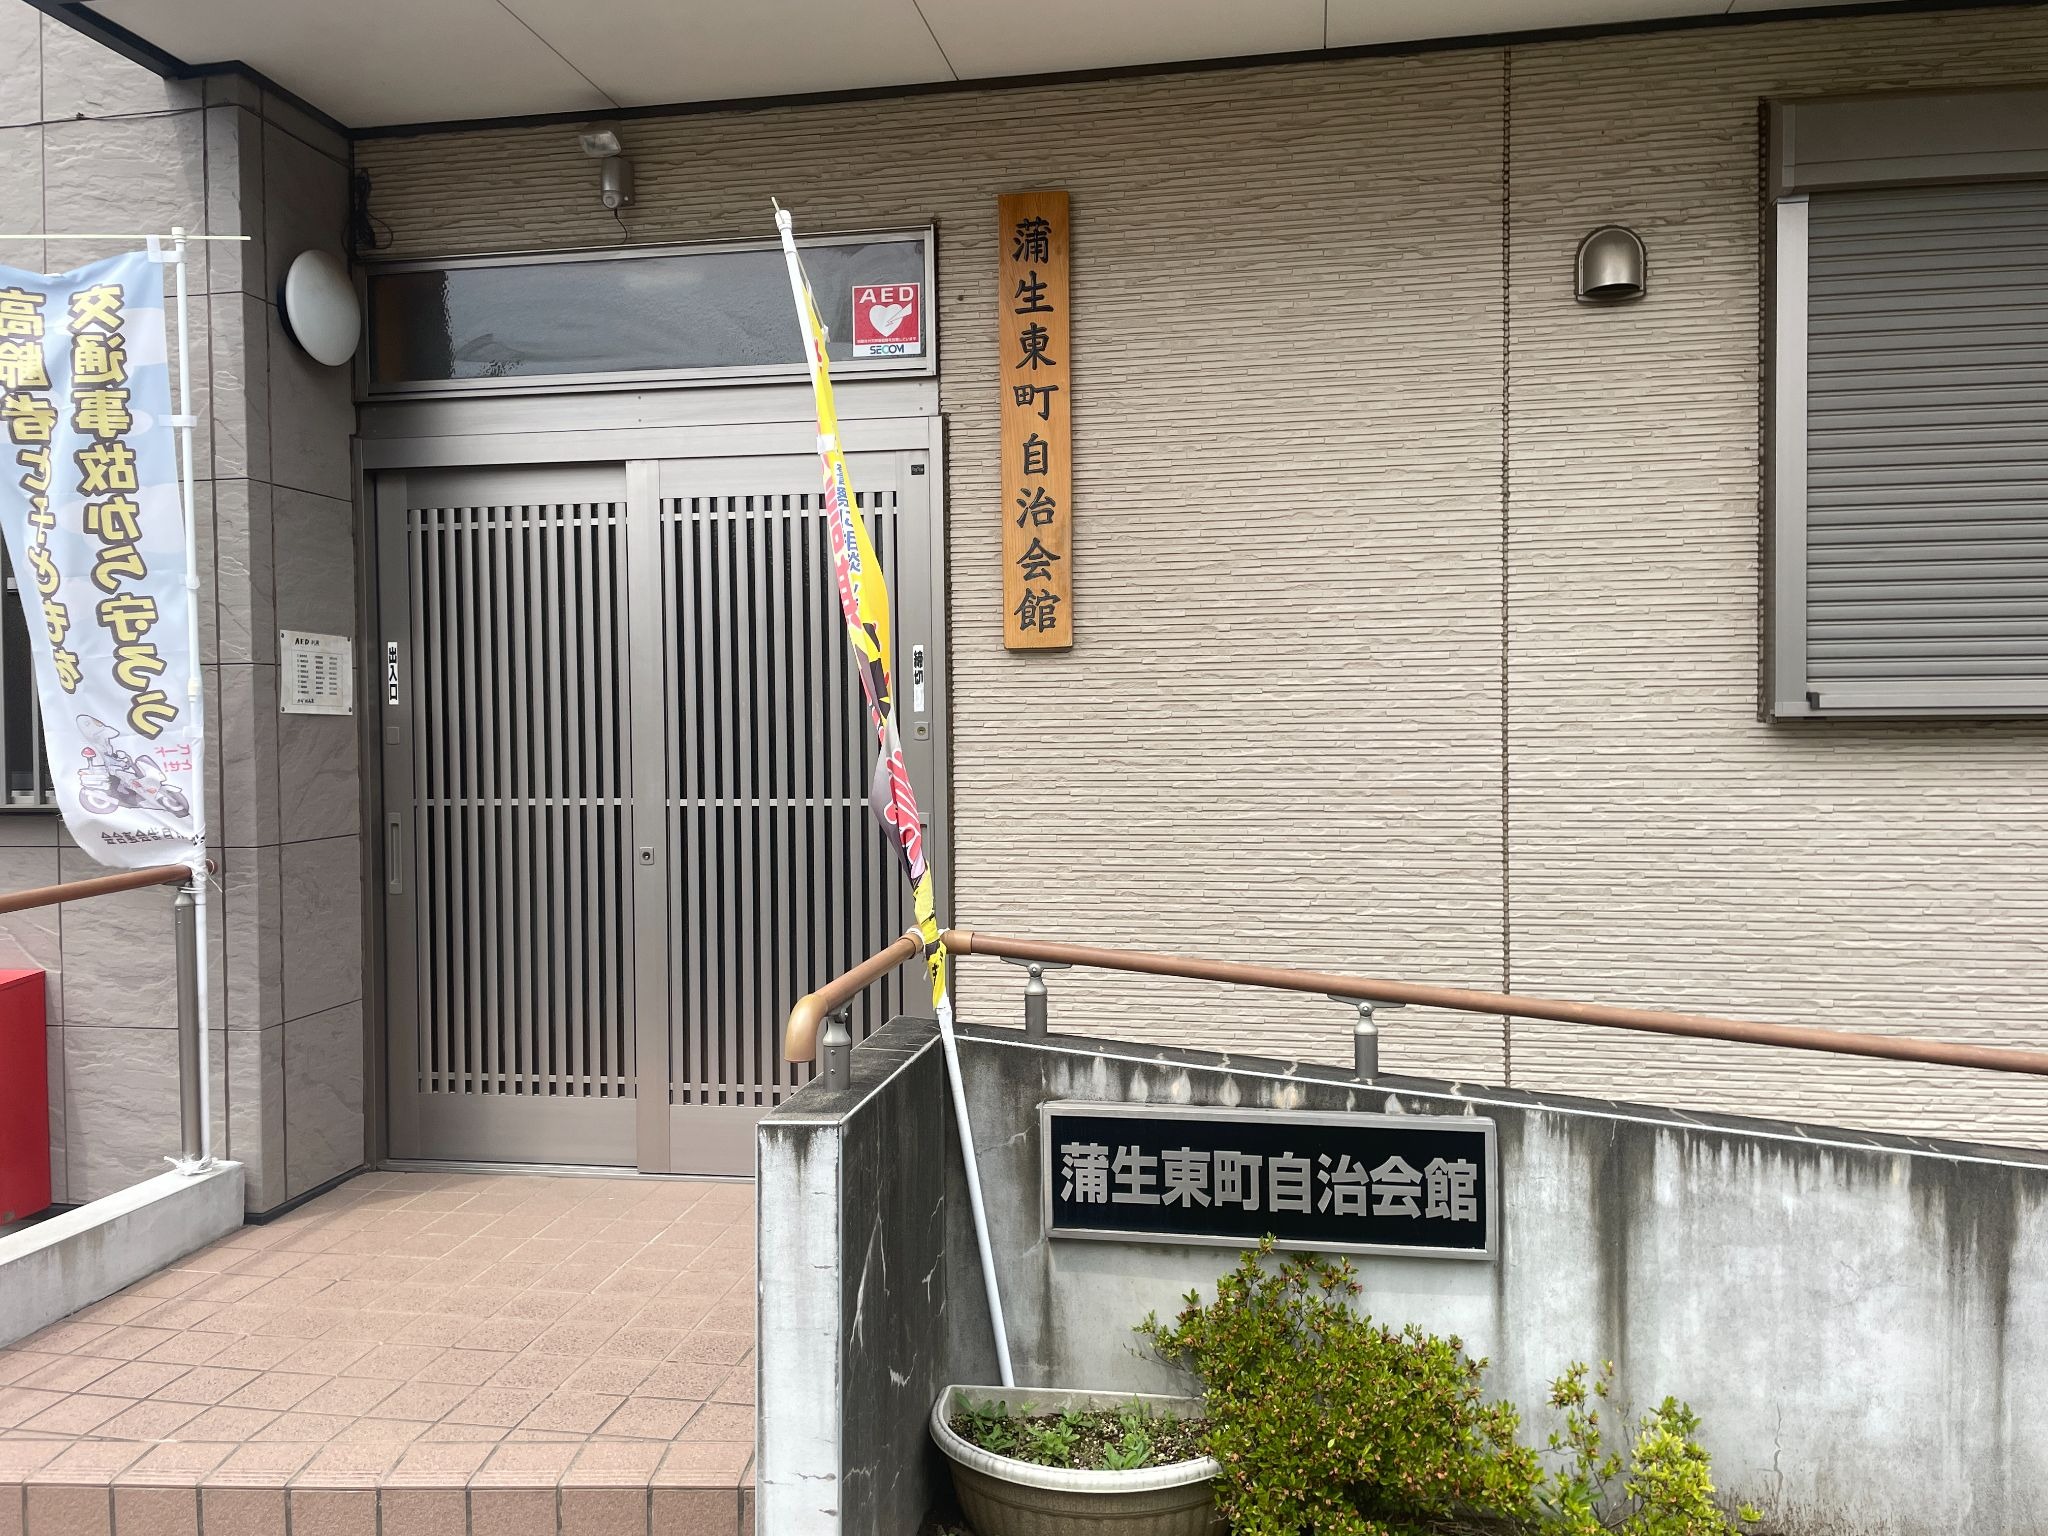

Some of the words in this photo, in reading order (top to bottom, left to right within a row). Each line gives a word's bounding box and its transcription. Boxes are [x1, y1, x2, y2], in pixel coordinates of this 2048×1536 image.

[859, 286, 914, 304] AED
[870, 344, 905, 355] SECOM
[1012, 216, 1062, 633] 蒲生東町自治会館
[388, 646, 398, 701] 出入口
[1060, 1141, 1478, 1222] 蒲生東町自治会館
